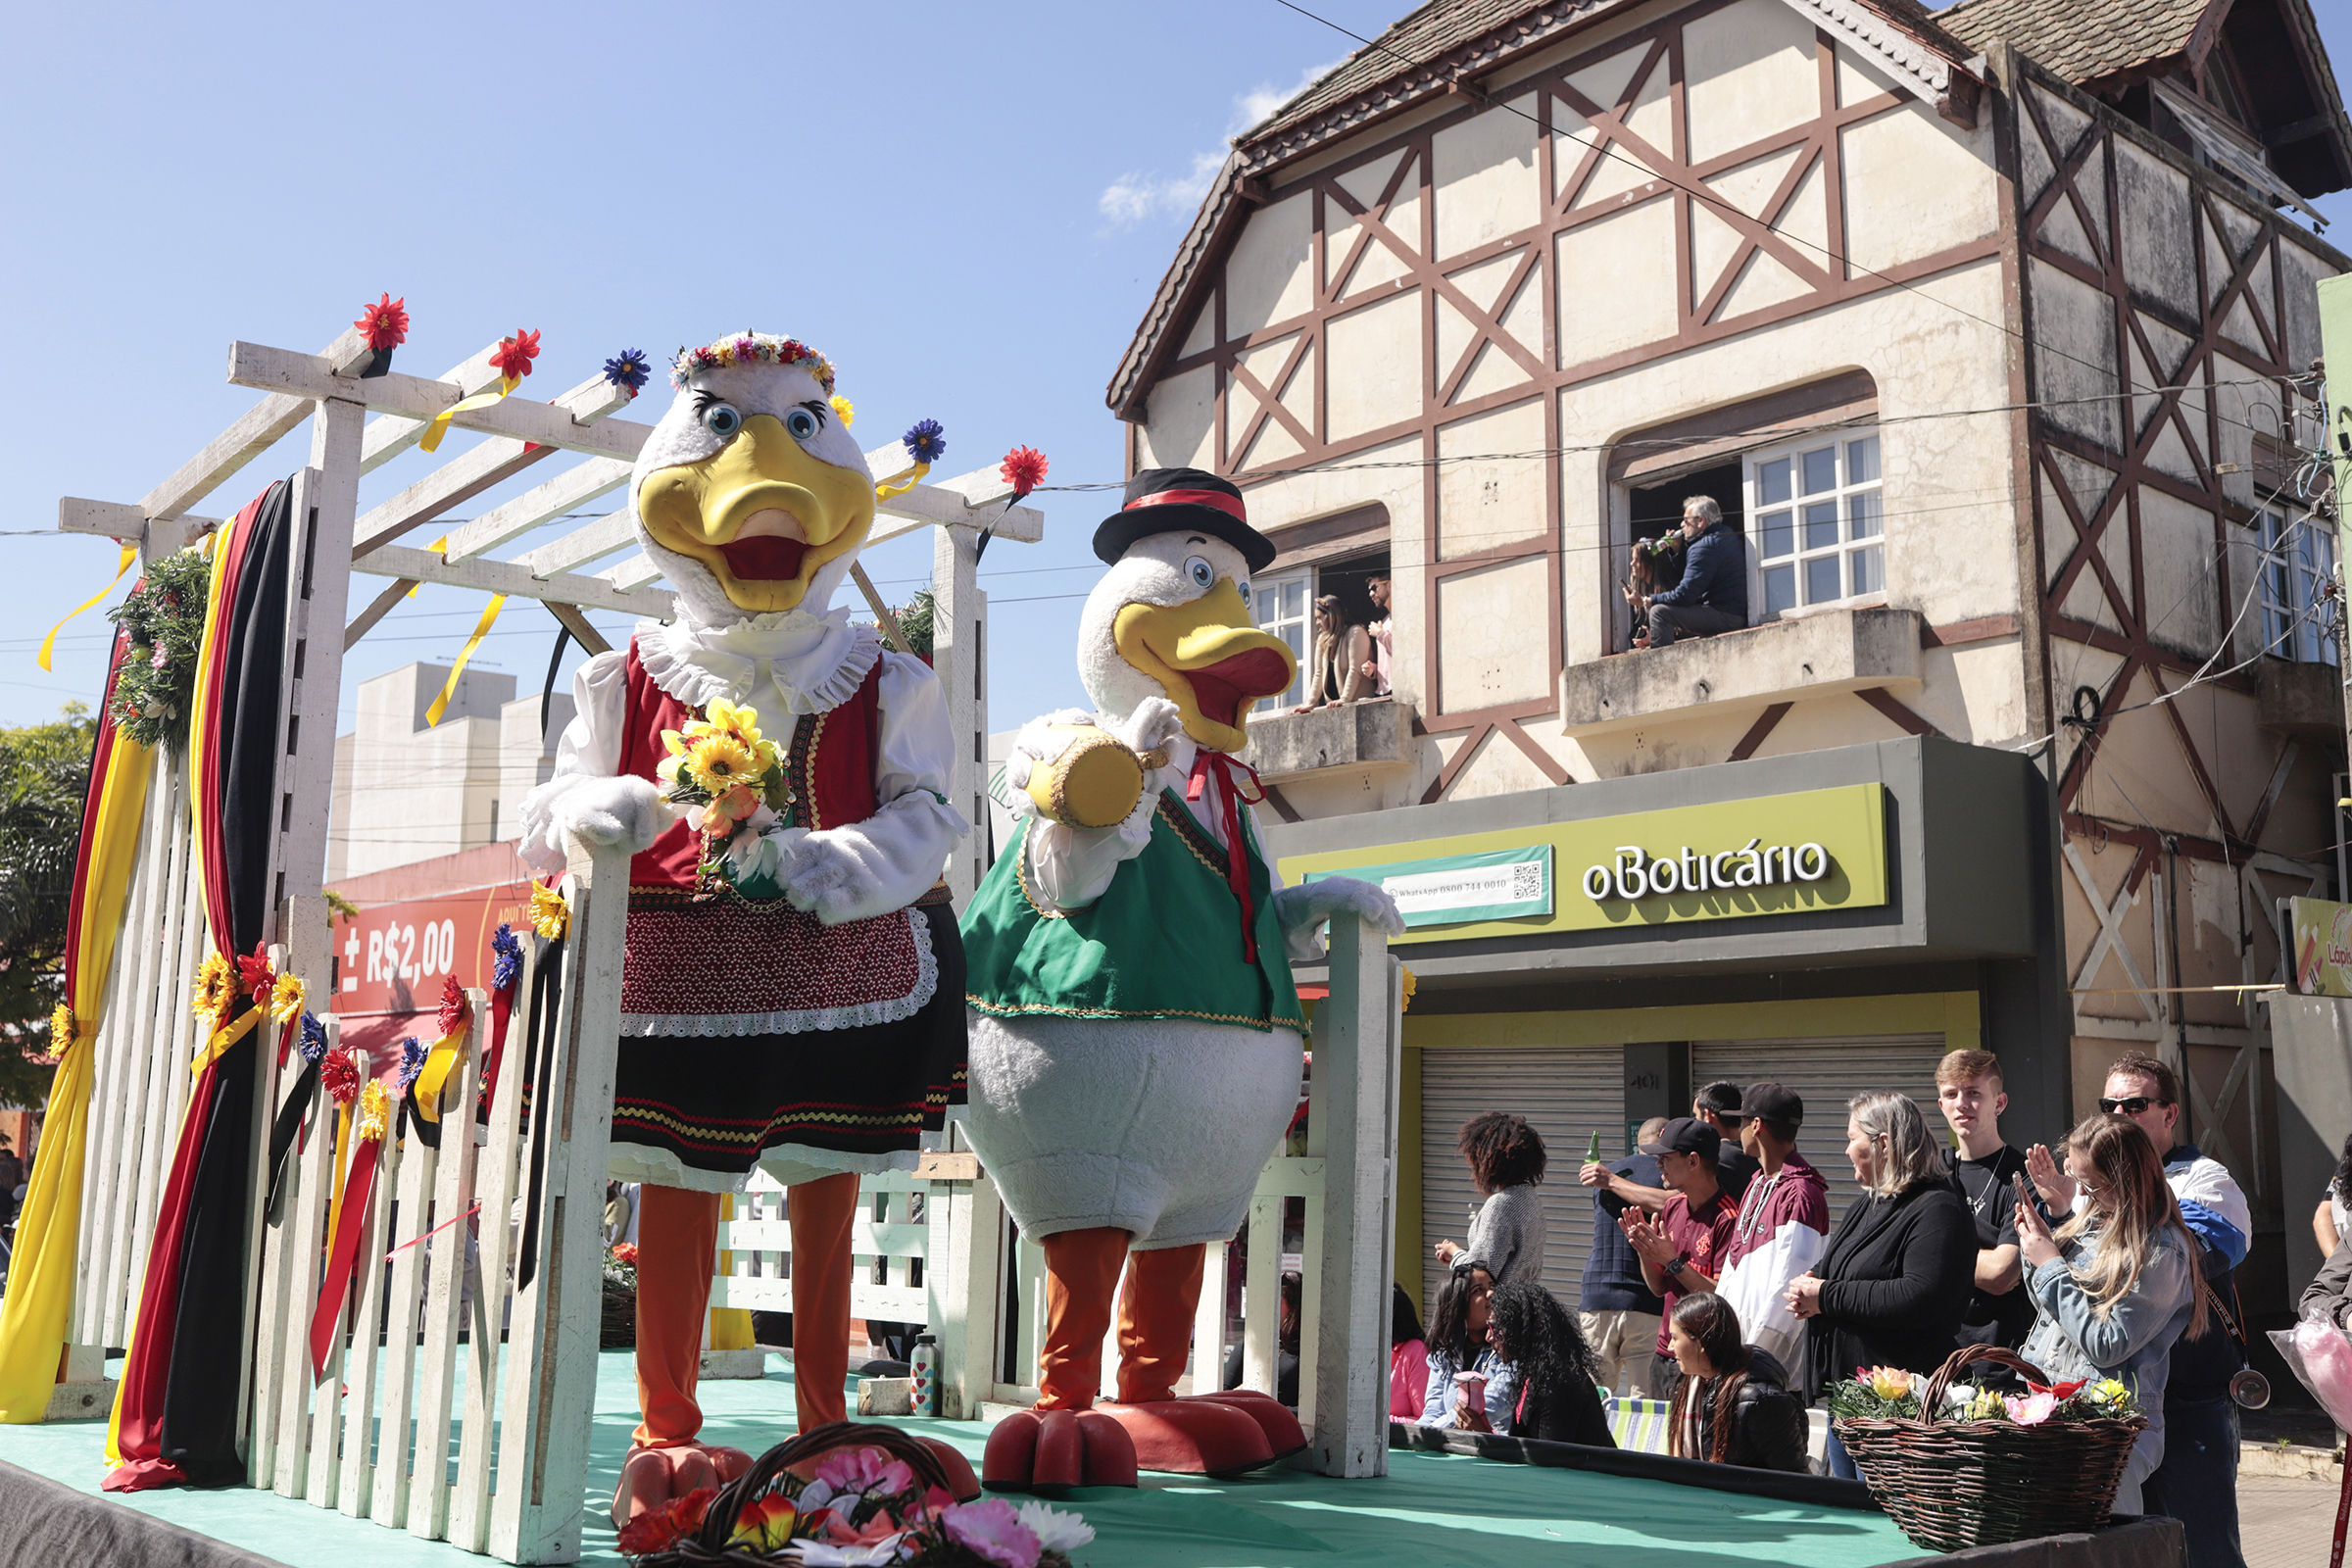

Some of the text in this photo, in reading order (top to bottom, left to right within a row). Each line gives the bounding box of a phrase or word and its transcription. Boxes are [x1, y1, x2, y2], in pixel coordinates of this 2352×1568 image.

[1398, 879, 1507, 898] WhatsApp 0800 744 0010
[497, 903, 532, 925] AQUI TE
[366, 917, 456, 991] R$2,00
[1630, 1072, 1659, 1090] 401
